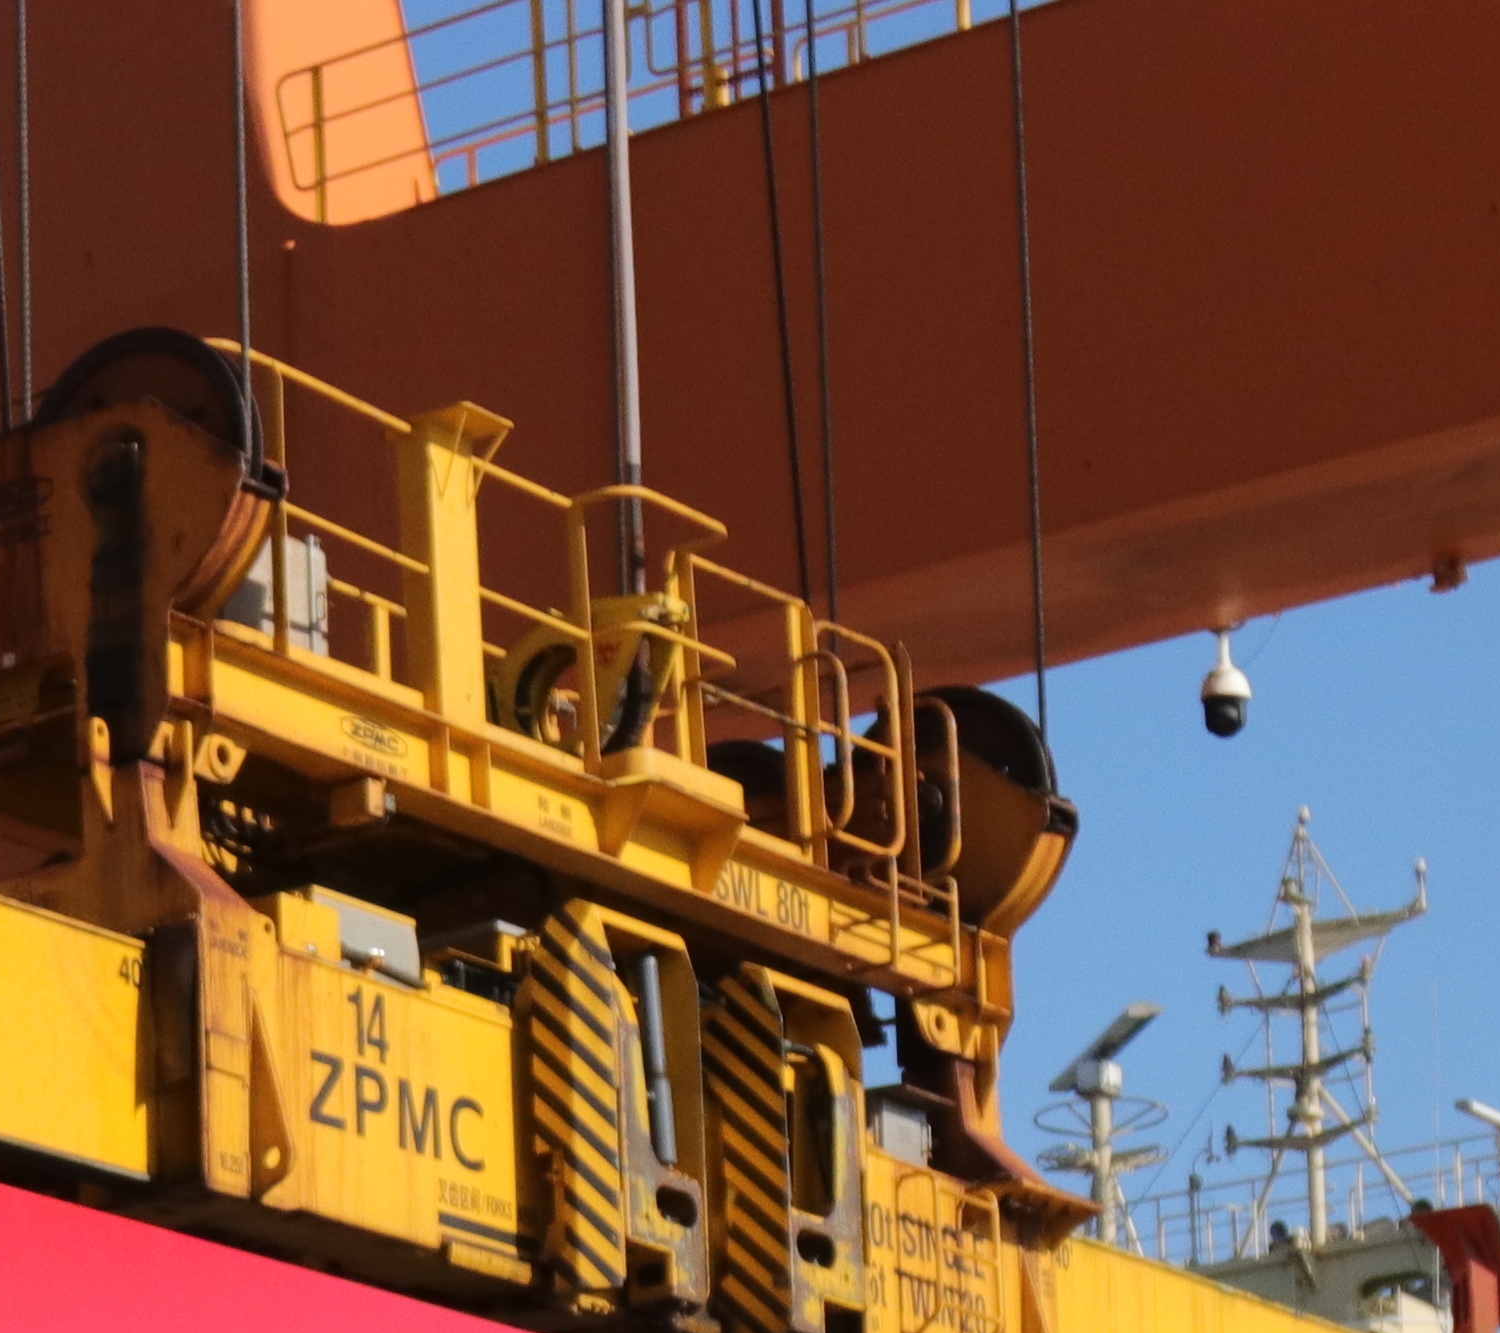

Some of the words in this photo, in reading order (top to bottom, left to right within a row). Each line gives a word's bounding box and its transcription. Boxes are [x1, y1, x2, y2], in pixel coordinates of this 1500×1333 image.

[716, 860, 769, 918] SWL
[348, 984, 389, 1064] 14
[309, 1048, 486, 1173] ZPMC
